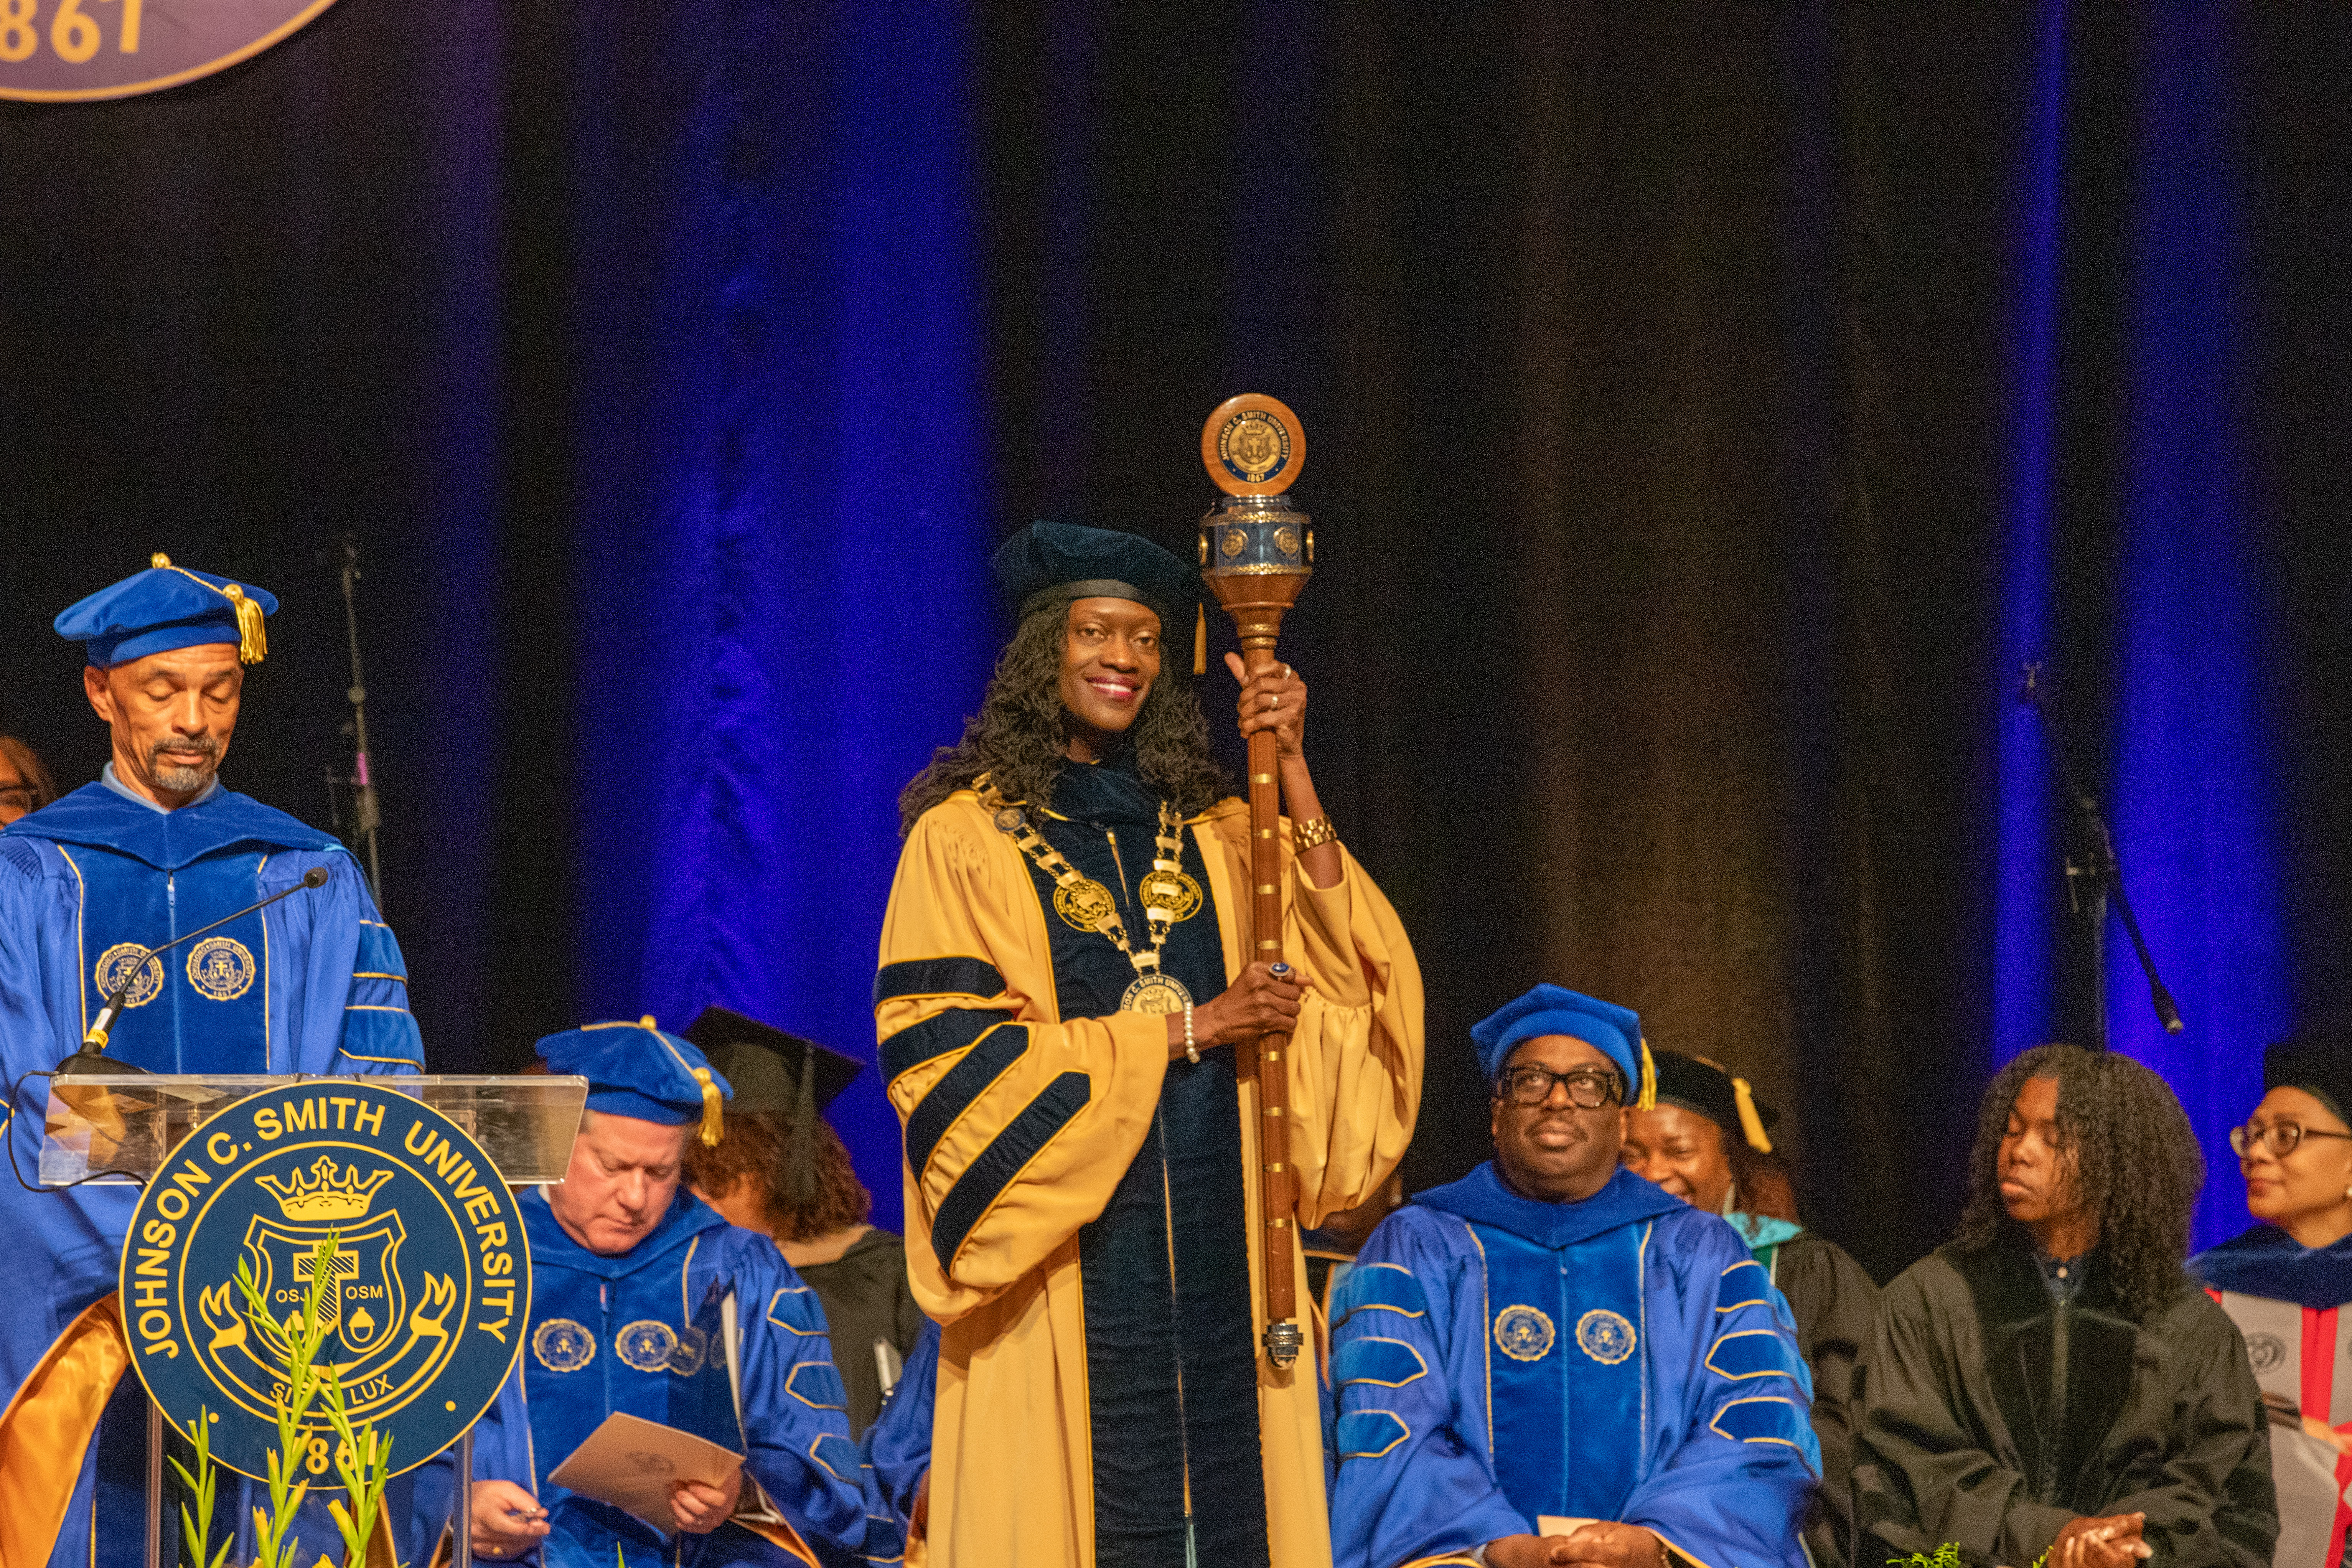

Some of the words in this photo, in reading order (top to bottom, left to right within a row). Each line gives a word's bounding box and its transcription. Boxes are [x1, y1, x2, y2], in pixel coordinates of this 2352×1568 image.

[1241, 411, 1267, 420] SMITH
[1139, 978, 1164, 988] SMITH
[135, 1159, 211, 1358] JOHNSON
[207, 1132, 252, 1164] C.
[254, 1097, 385, 1140] SMITH
[405, 1121, 515, 1343] UNIVERSITY
[345, 1285, 383, 1300] OSM
[270, 1382, 306, 1403] SI
[350, 1374, 394, 1405] LUX
